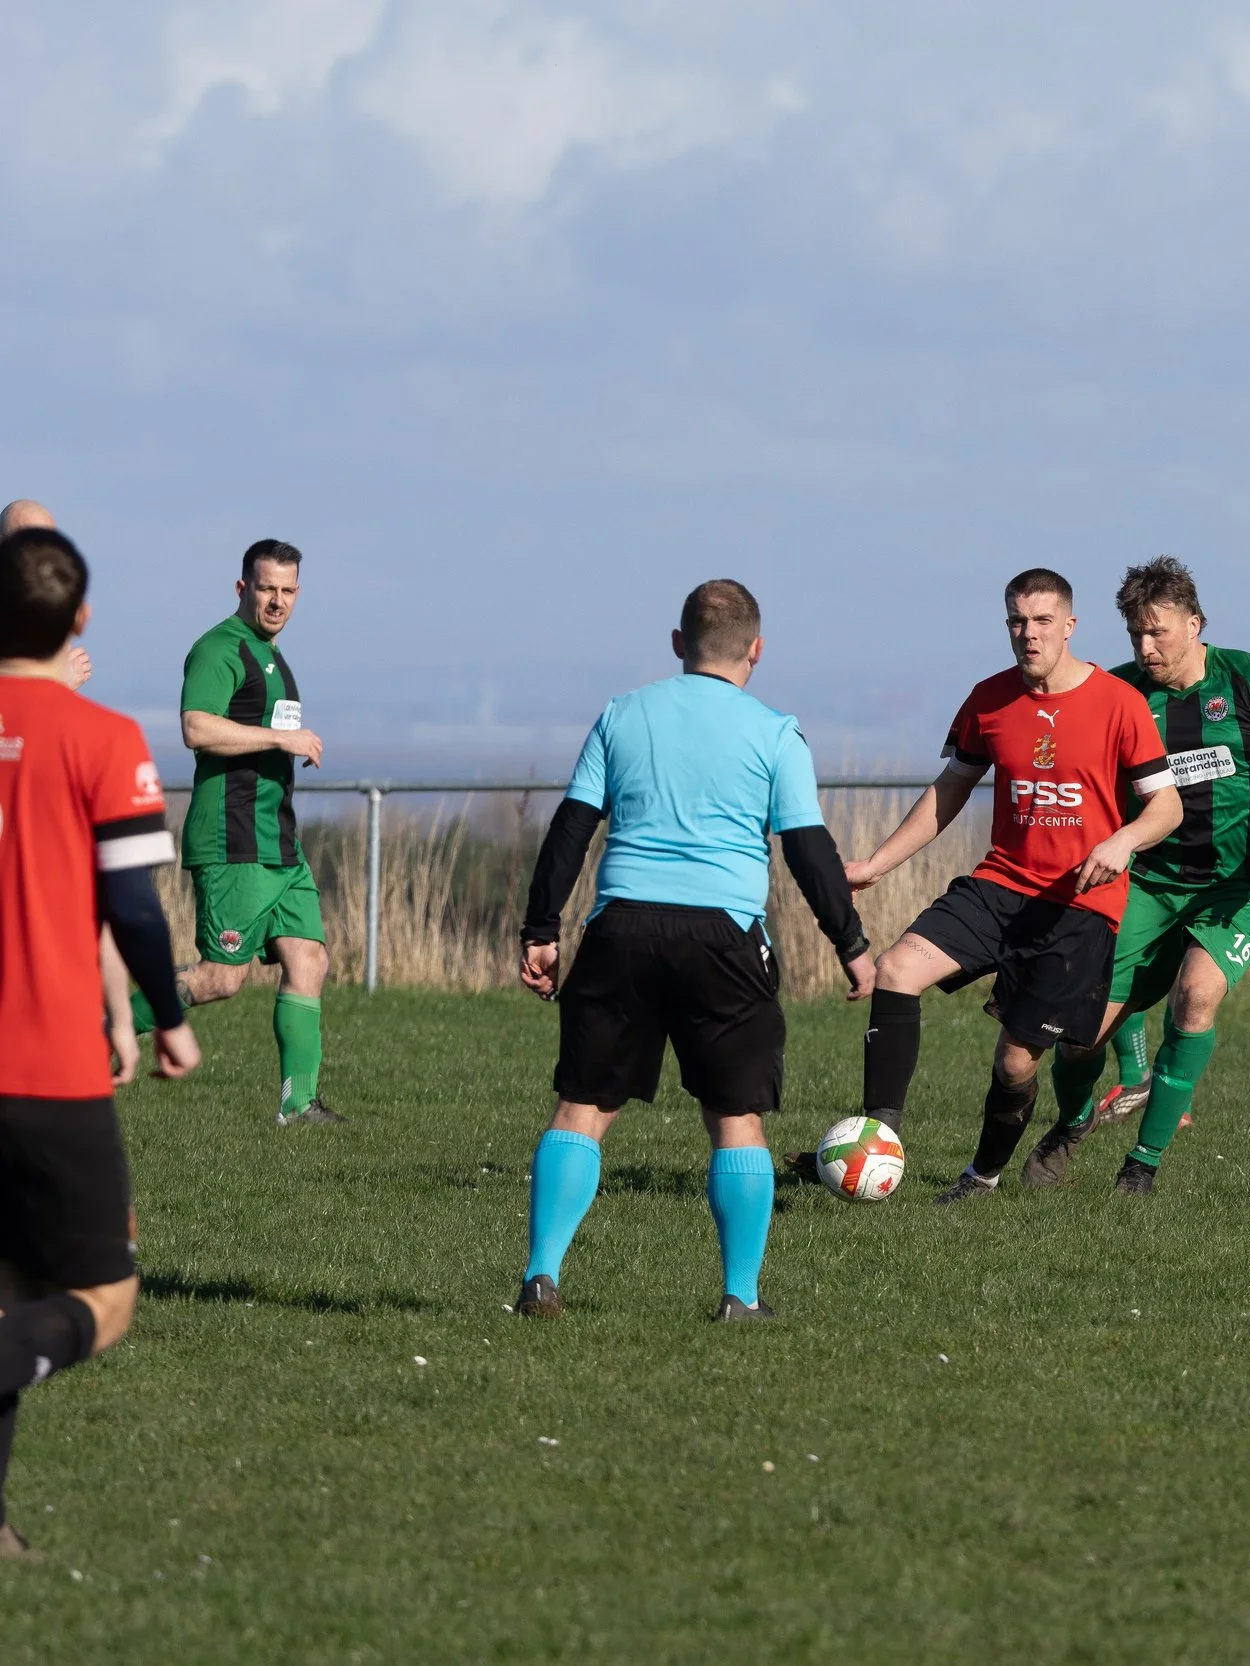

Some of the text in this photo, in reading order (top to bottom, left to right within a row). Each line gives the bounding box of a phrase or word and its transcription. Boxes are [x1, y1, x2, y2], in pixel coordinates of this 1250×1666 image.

[1168, 750, 1217, 766] Lakeland
[1171, 759, 1231, 776] Verandahs
[1011, 780, 1083, 807] PSS
[1012, 814, 1083, 827] AUTO CENTRE
